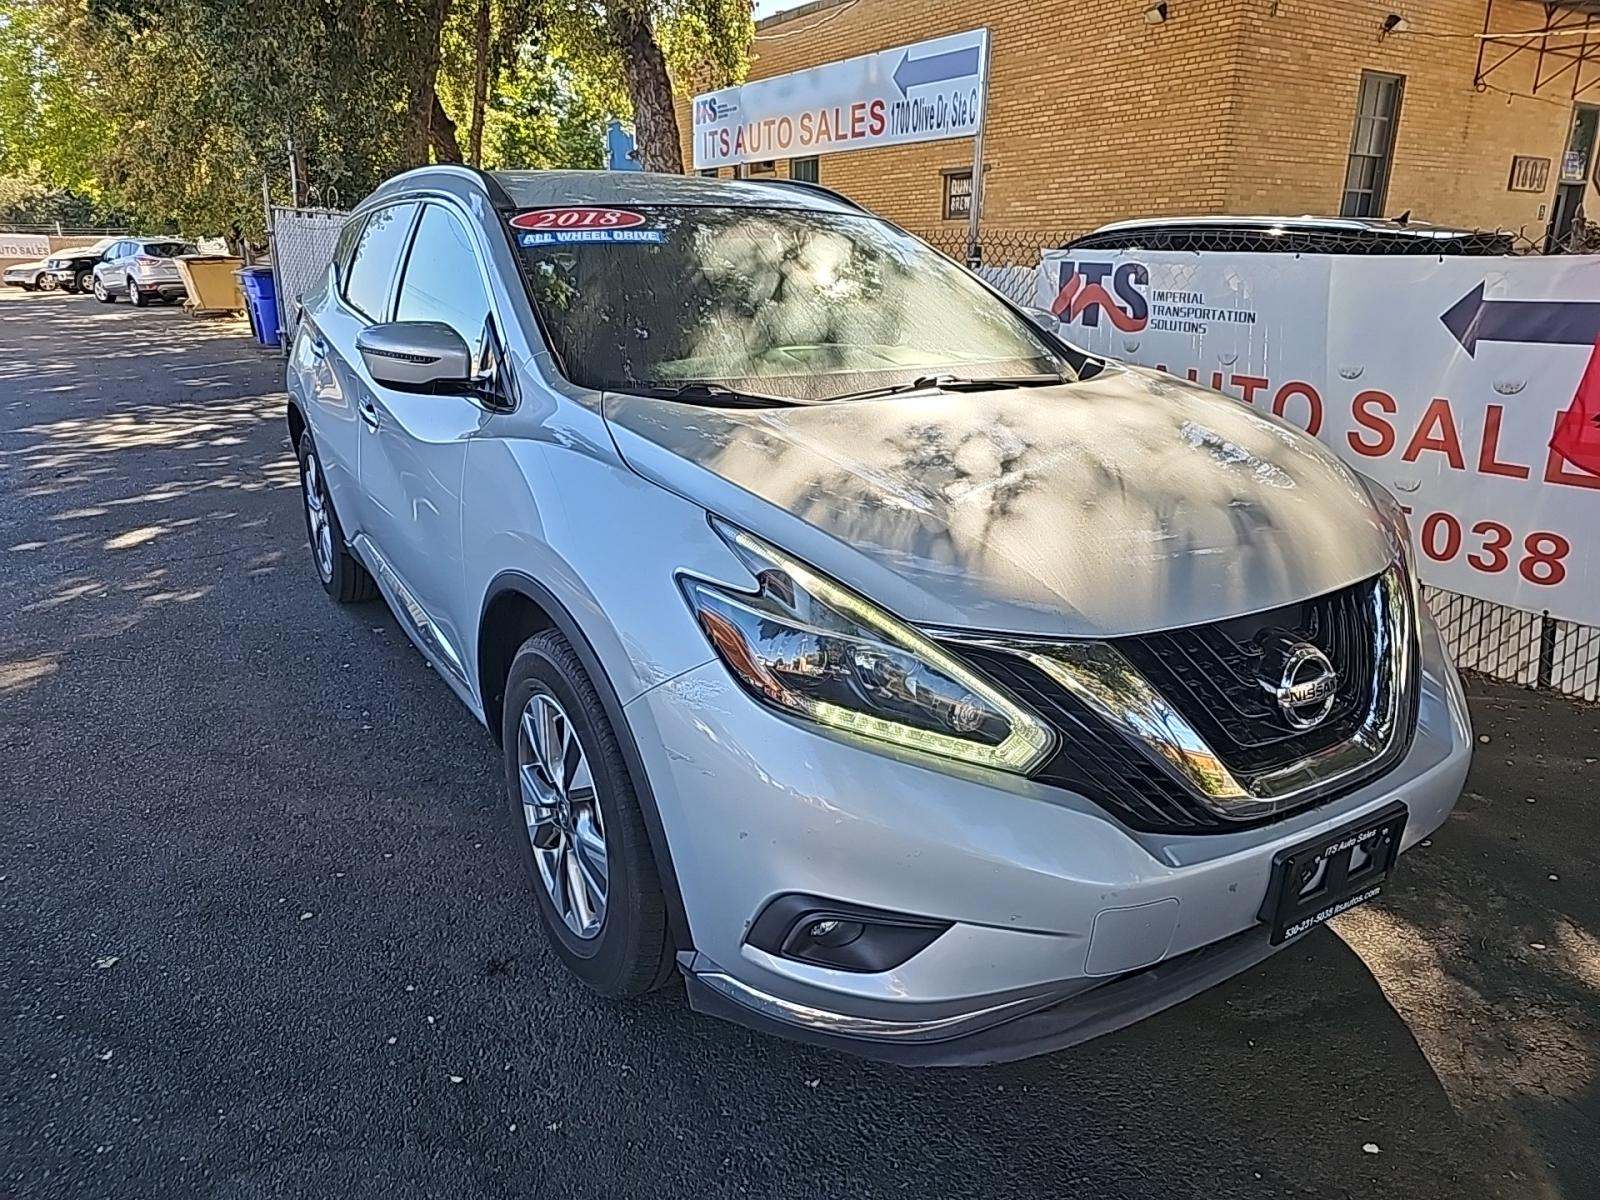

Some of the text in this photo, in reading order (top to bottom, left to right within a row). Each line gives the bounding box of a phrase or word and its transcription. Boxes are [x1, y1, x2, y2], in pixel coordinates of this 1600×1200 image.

[696, 98, 717, 125] ITS
[890, 99, 911, 136] 1700
[911, 97, 935, 133] Olive
[951, 91, 967, 127] Ste
[968, 87, 977, 125] C
[703, 99, 885, 159] ITS AUTO SALES
[533, 211, 621, 228] 2018
[523, 230, 660, 245] ALL WHEEL DRIVE
[20, 247, 49, 256] SALES
[1052, 261, 1149, 333] ITS
[1152, 290, 1206, 305] IMPERIAL
[1150, 319, 1208, 334] SOLUTONS
[1151, 305, 1257, 324] TRANSPORTATION
[1156, 364, 1323, 437] TO
[1402, 505, 1570, 586] 038
[1289, 677, 1337, 702] NISSAN
[1325, 829, 1377, 857] ITS Auto Sales
